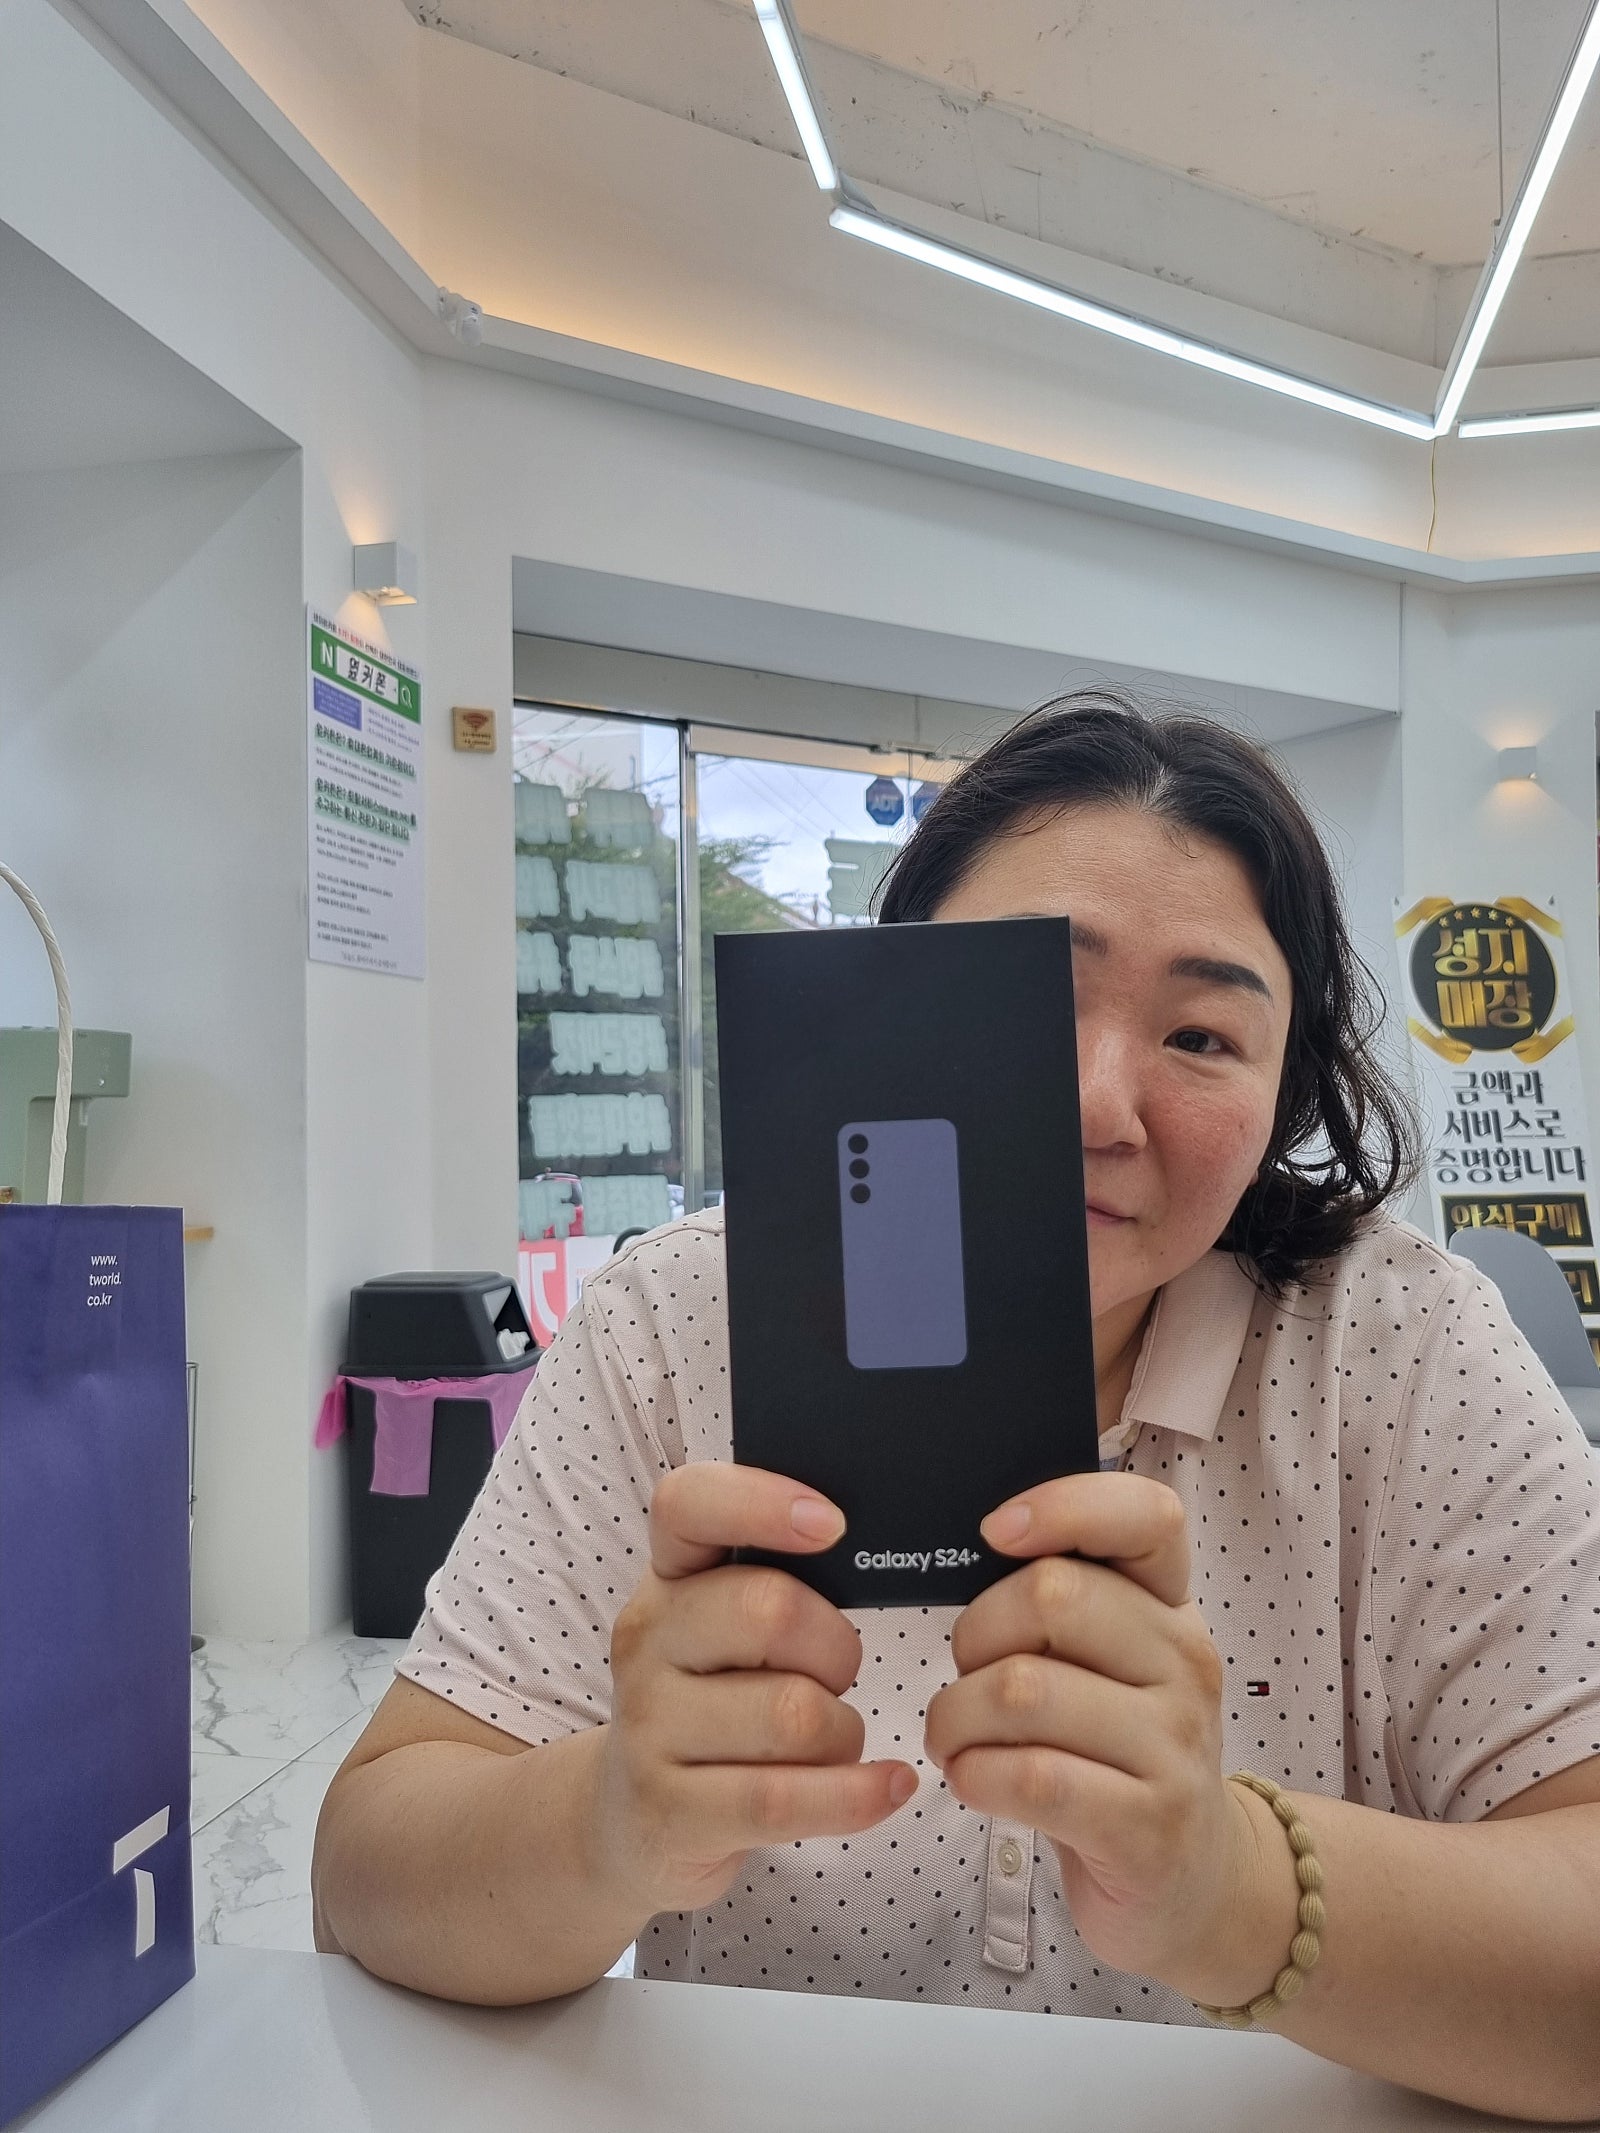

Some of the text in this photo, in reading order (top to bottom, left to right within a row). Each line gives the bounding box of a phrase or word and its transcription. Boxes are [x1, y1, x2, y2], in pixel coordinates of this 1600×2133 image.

[320, 642, 334, 668] N
[1434, 927, 1528, 977] 성지
[1435, 978, 1534, 1029] 매장
[1449, 1070, 1545, 1106] 금액과
[1442, 1108, 1566, 1144] 서비스로
[1431, 1145, 1587, 1184] 증명합니다
[91, 1255, 118, 1266] www.
[89, 1272, 121, 1286] tworld.
[87, 1292, 112, 1306] co.kr
[854, 1547, 982, 1573] Galaxy S24+
